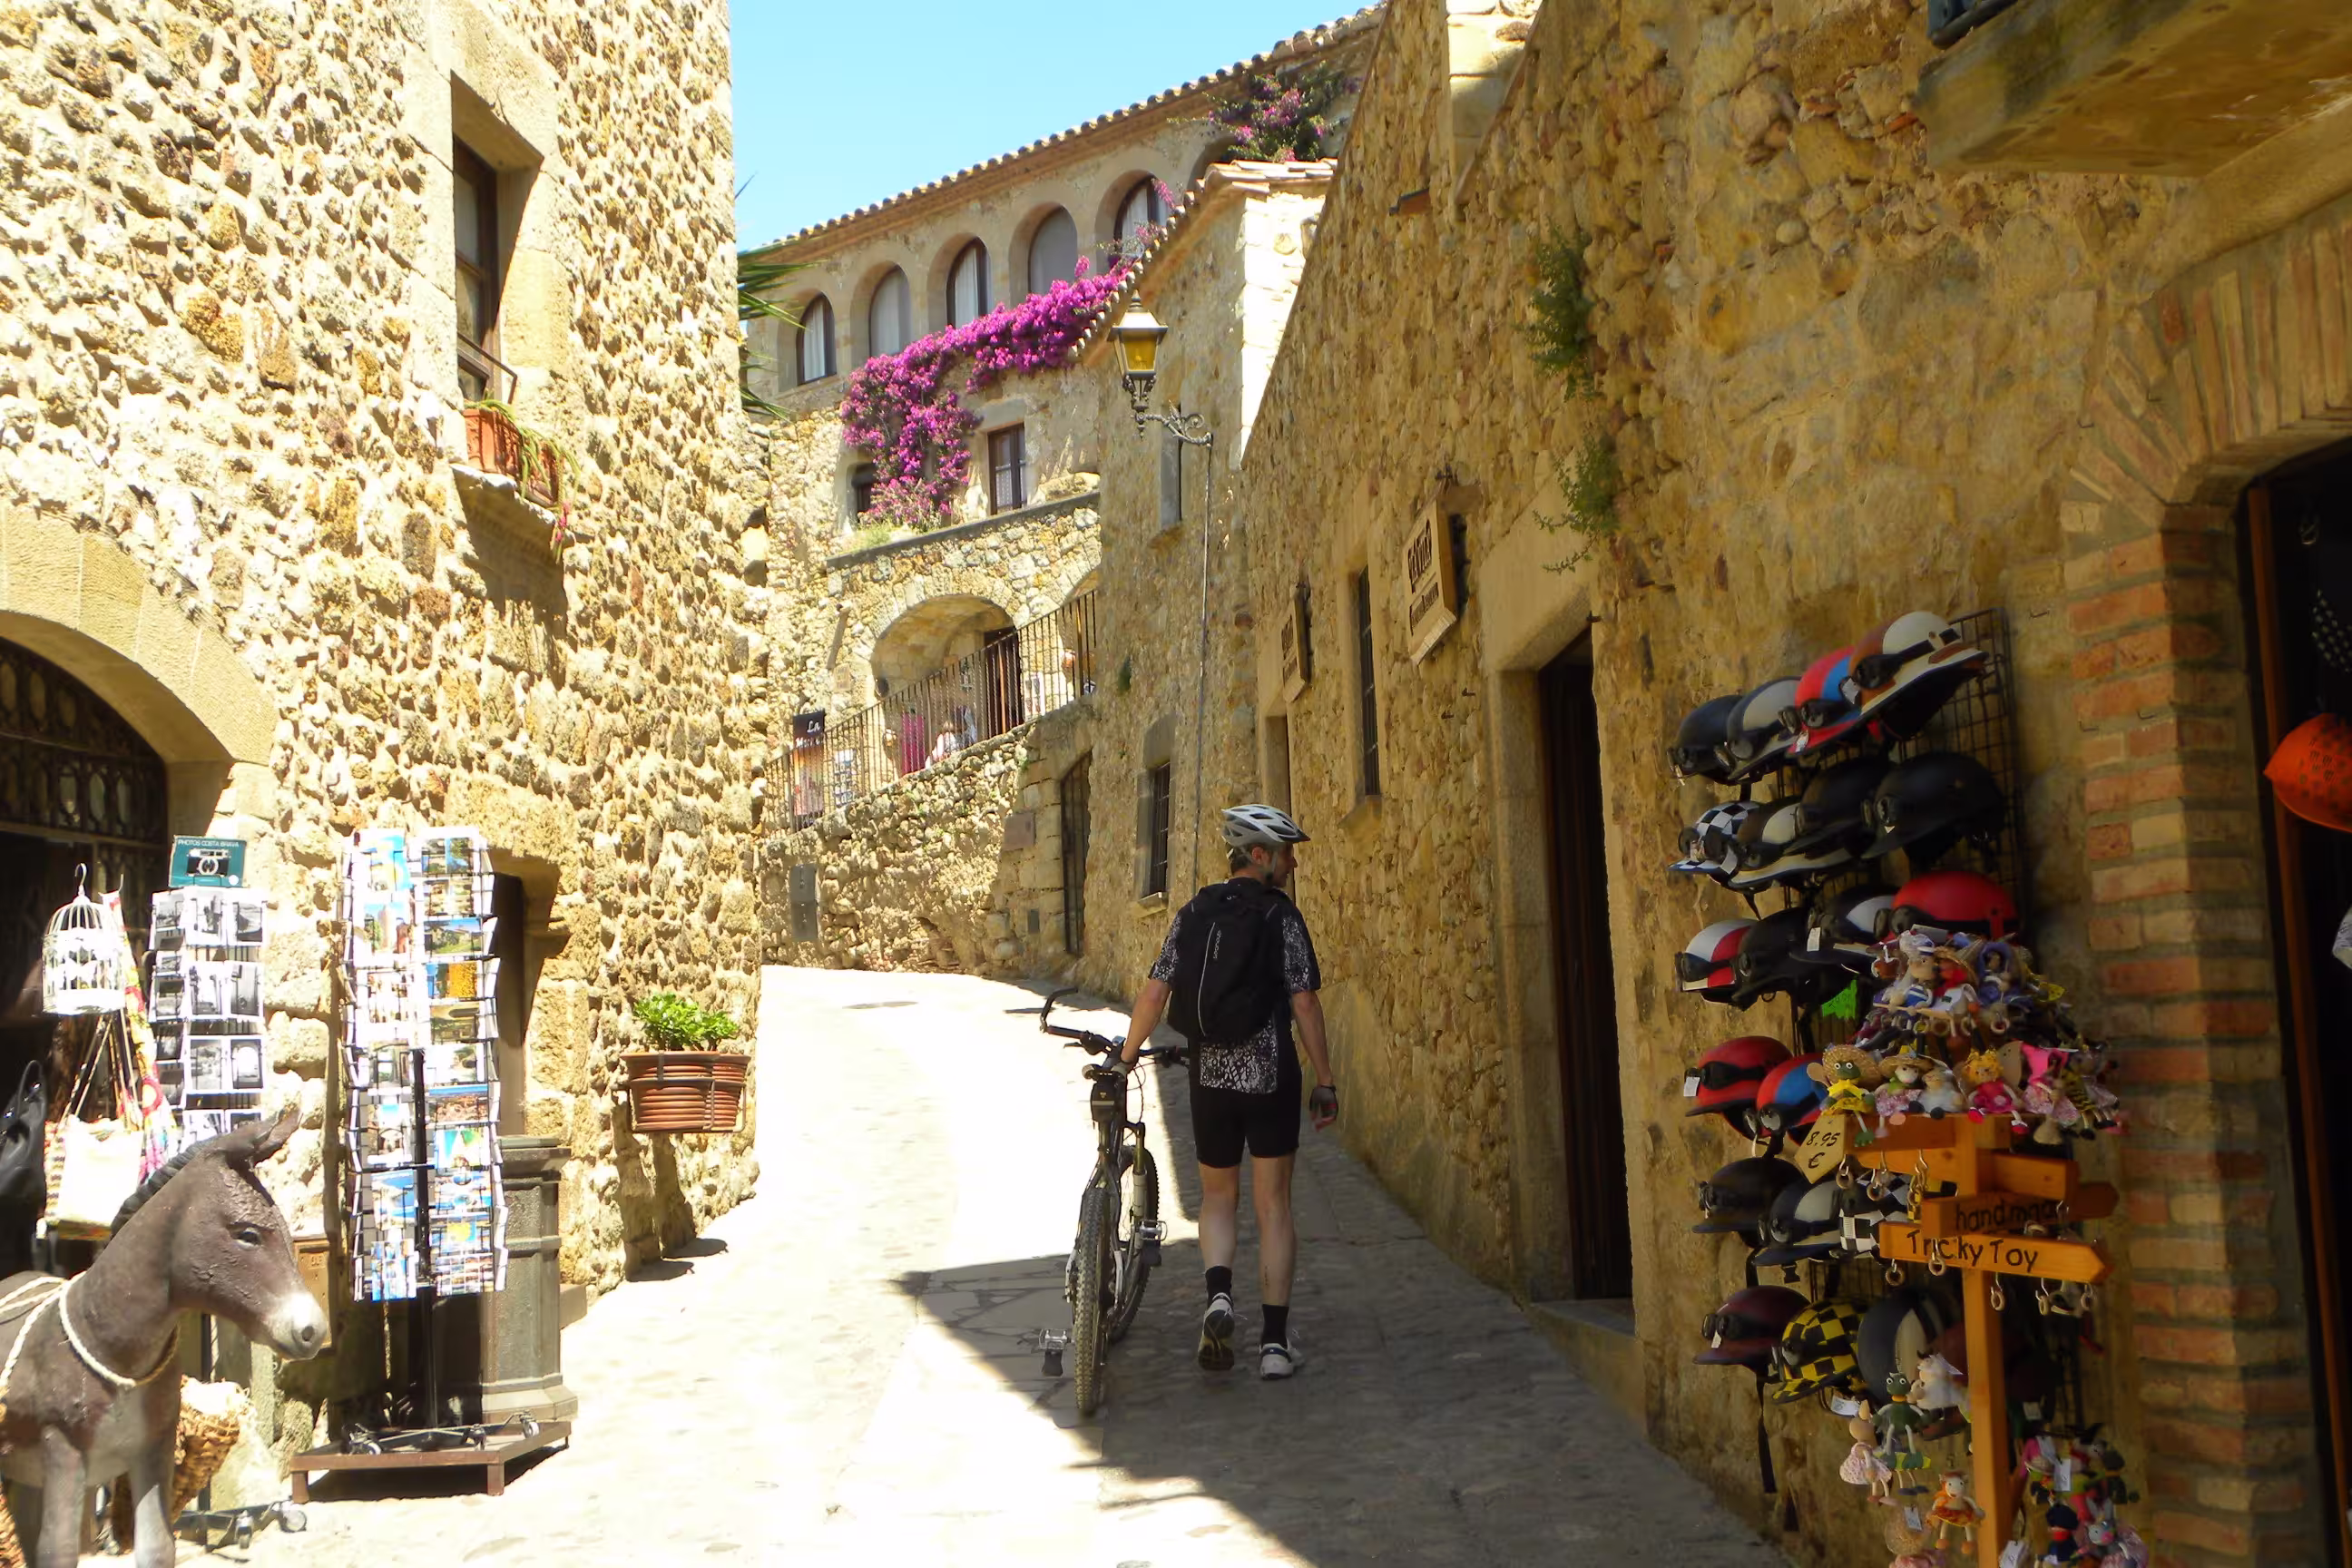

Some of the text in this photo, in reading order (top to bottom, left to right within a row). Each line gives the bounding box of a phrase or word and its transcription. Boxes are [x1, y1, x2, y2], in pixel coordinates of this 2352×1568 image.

[178, 838, 201, 847] PHOTOS
[1806, 1131, 1841, 1147] 8.95
[1808, 1152, 1826, 1169] €
[1906, 1229, 2039, 1273] Tricky Toy
